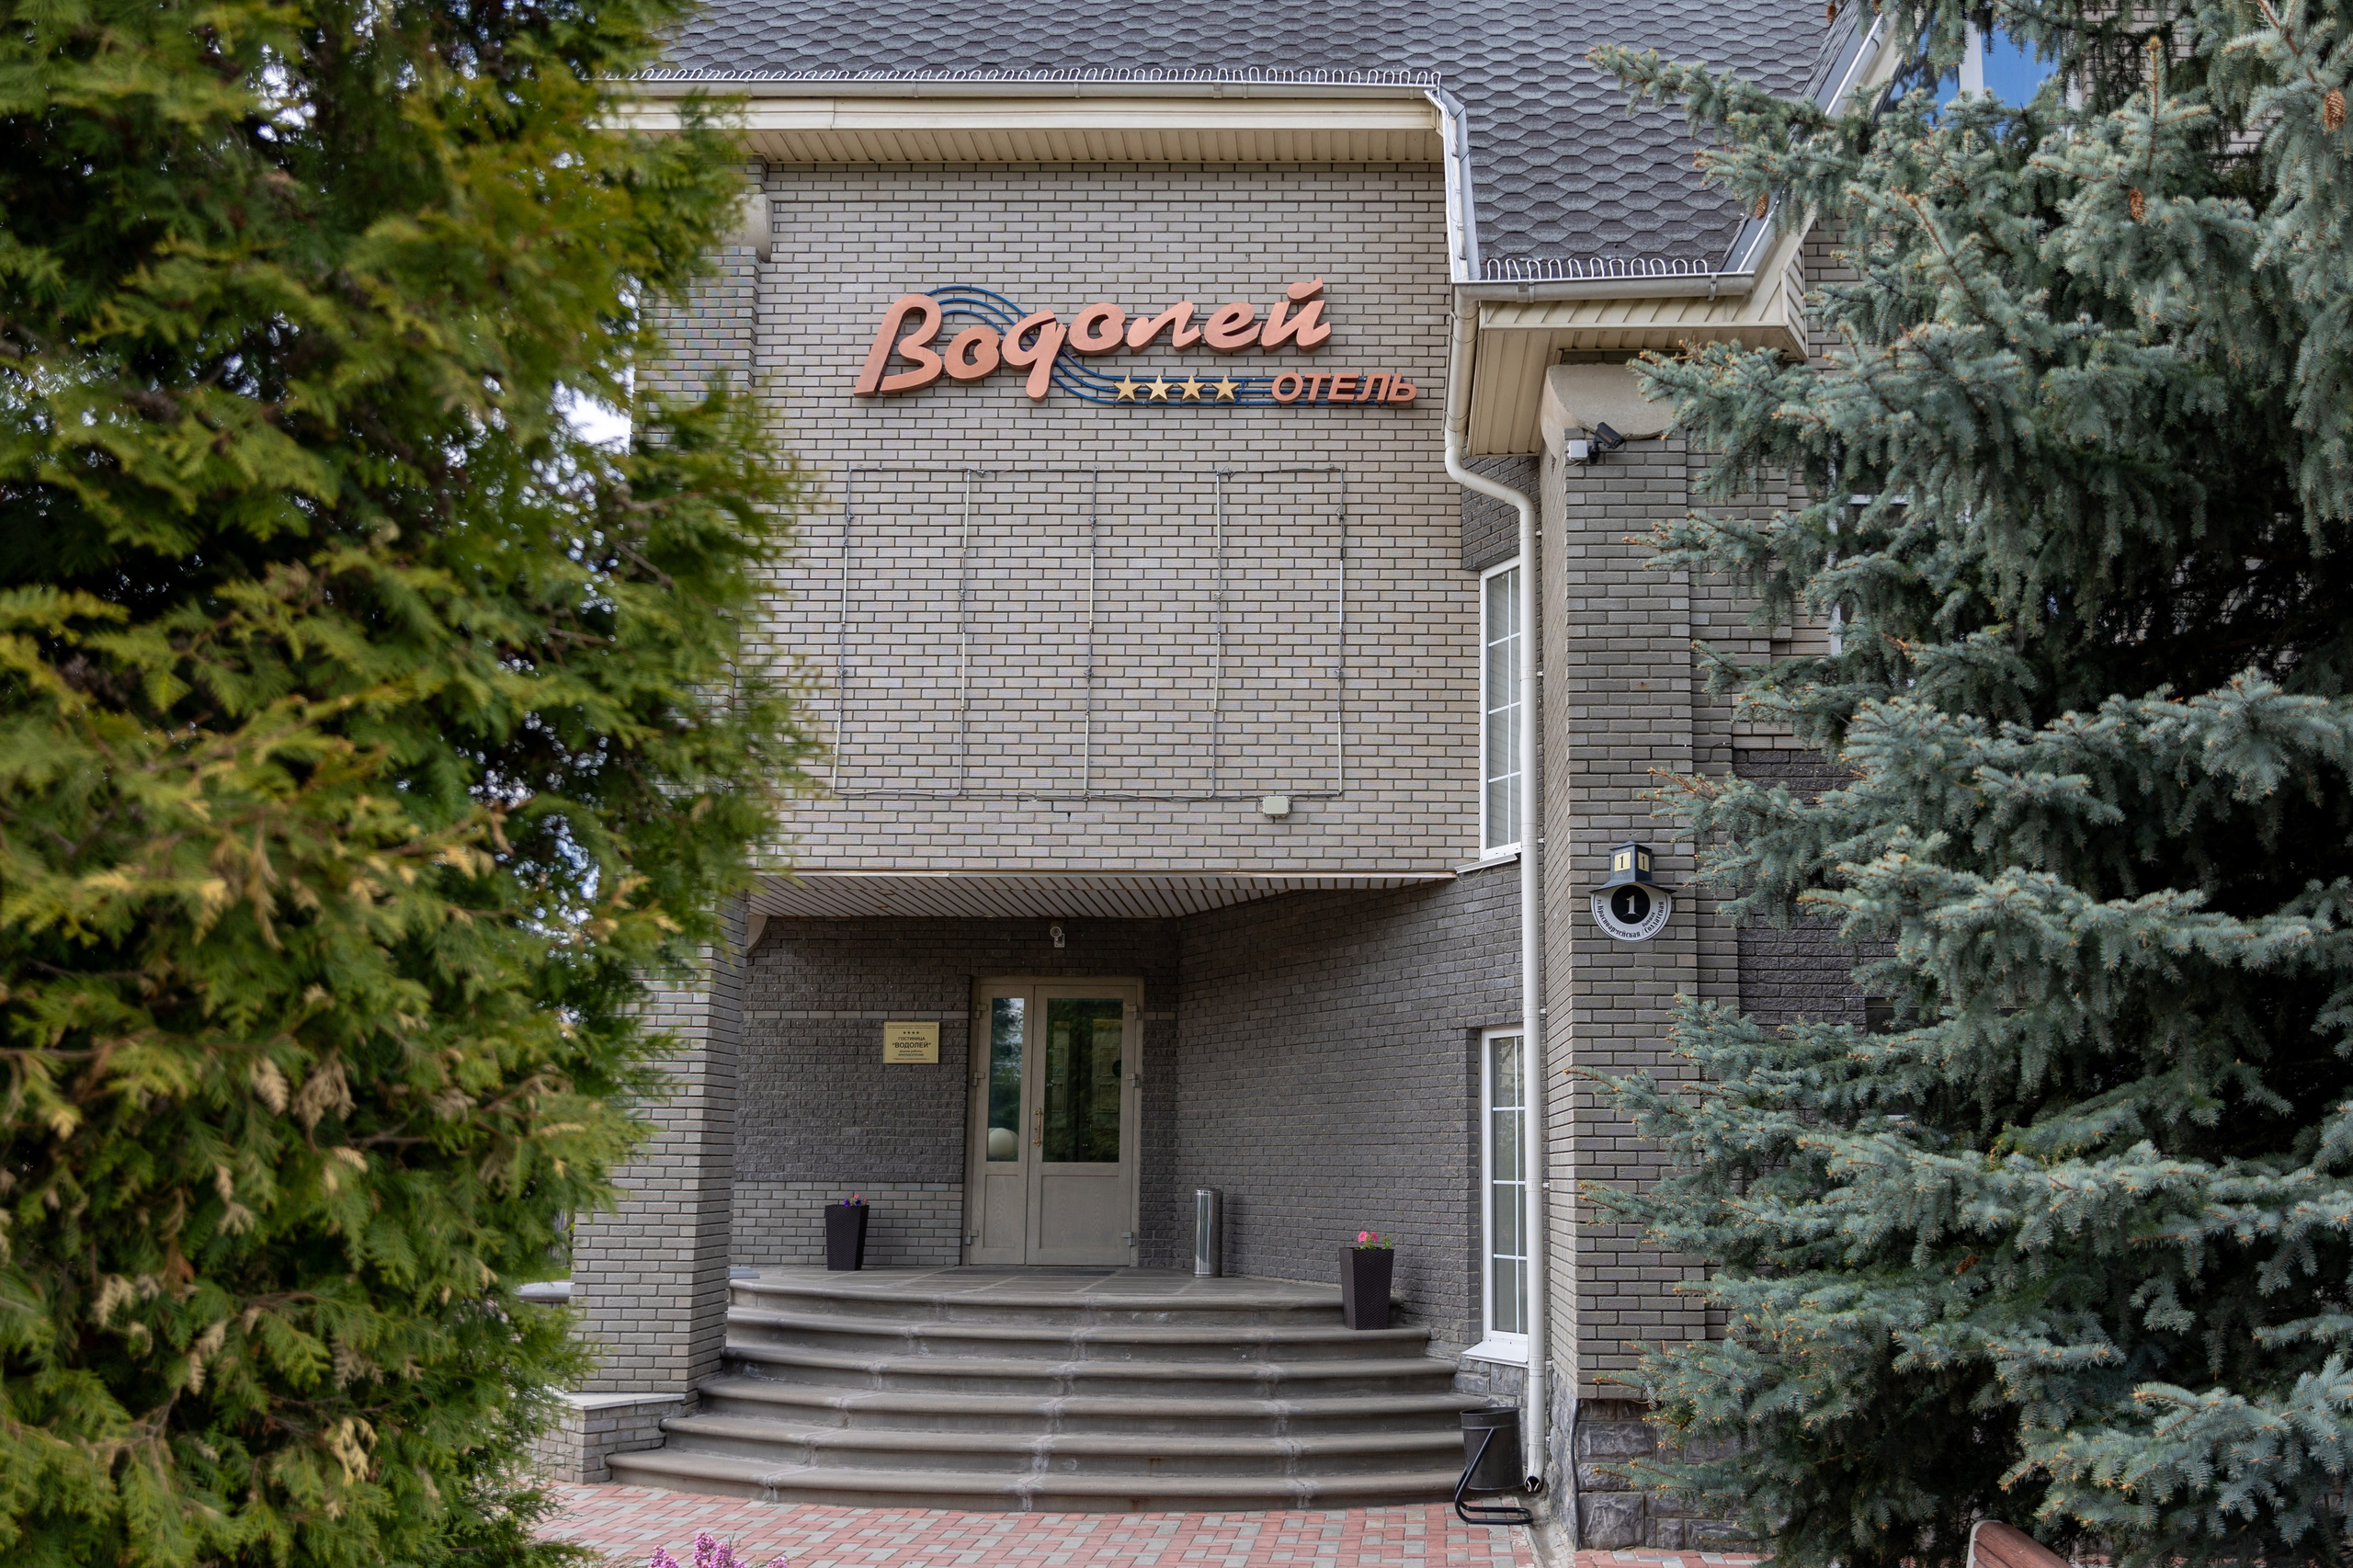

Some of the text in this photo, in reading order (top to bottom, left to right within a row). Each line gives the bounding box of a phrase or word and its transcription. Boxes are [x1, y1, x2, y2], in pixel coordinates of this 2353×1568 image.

[853, 276, 1332, 403] Водолей
[1271, 371, 1418, 404] ОТЕЛЬ
[1620, 855, 1624, 869] 1
[1642, 856, 1645, 869] 1
[1626, 894, 1636, 915] 1
[1597, 904, 1641, 938] Красноармейская
[1644, 901, 1665, 934] Солдатская
